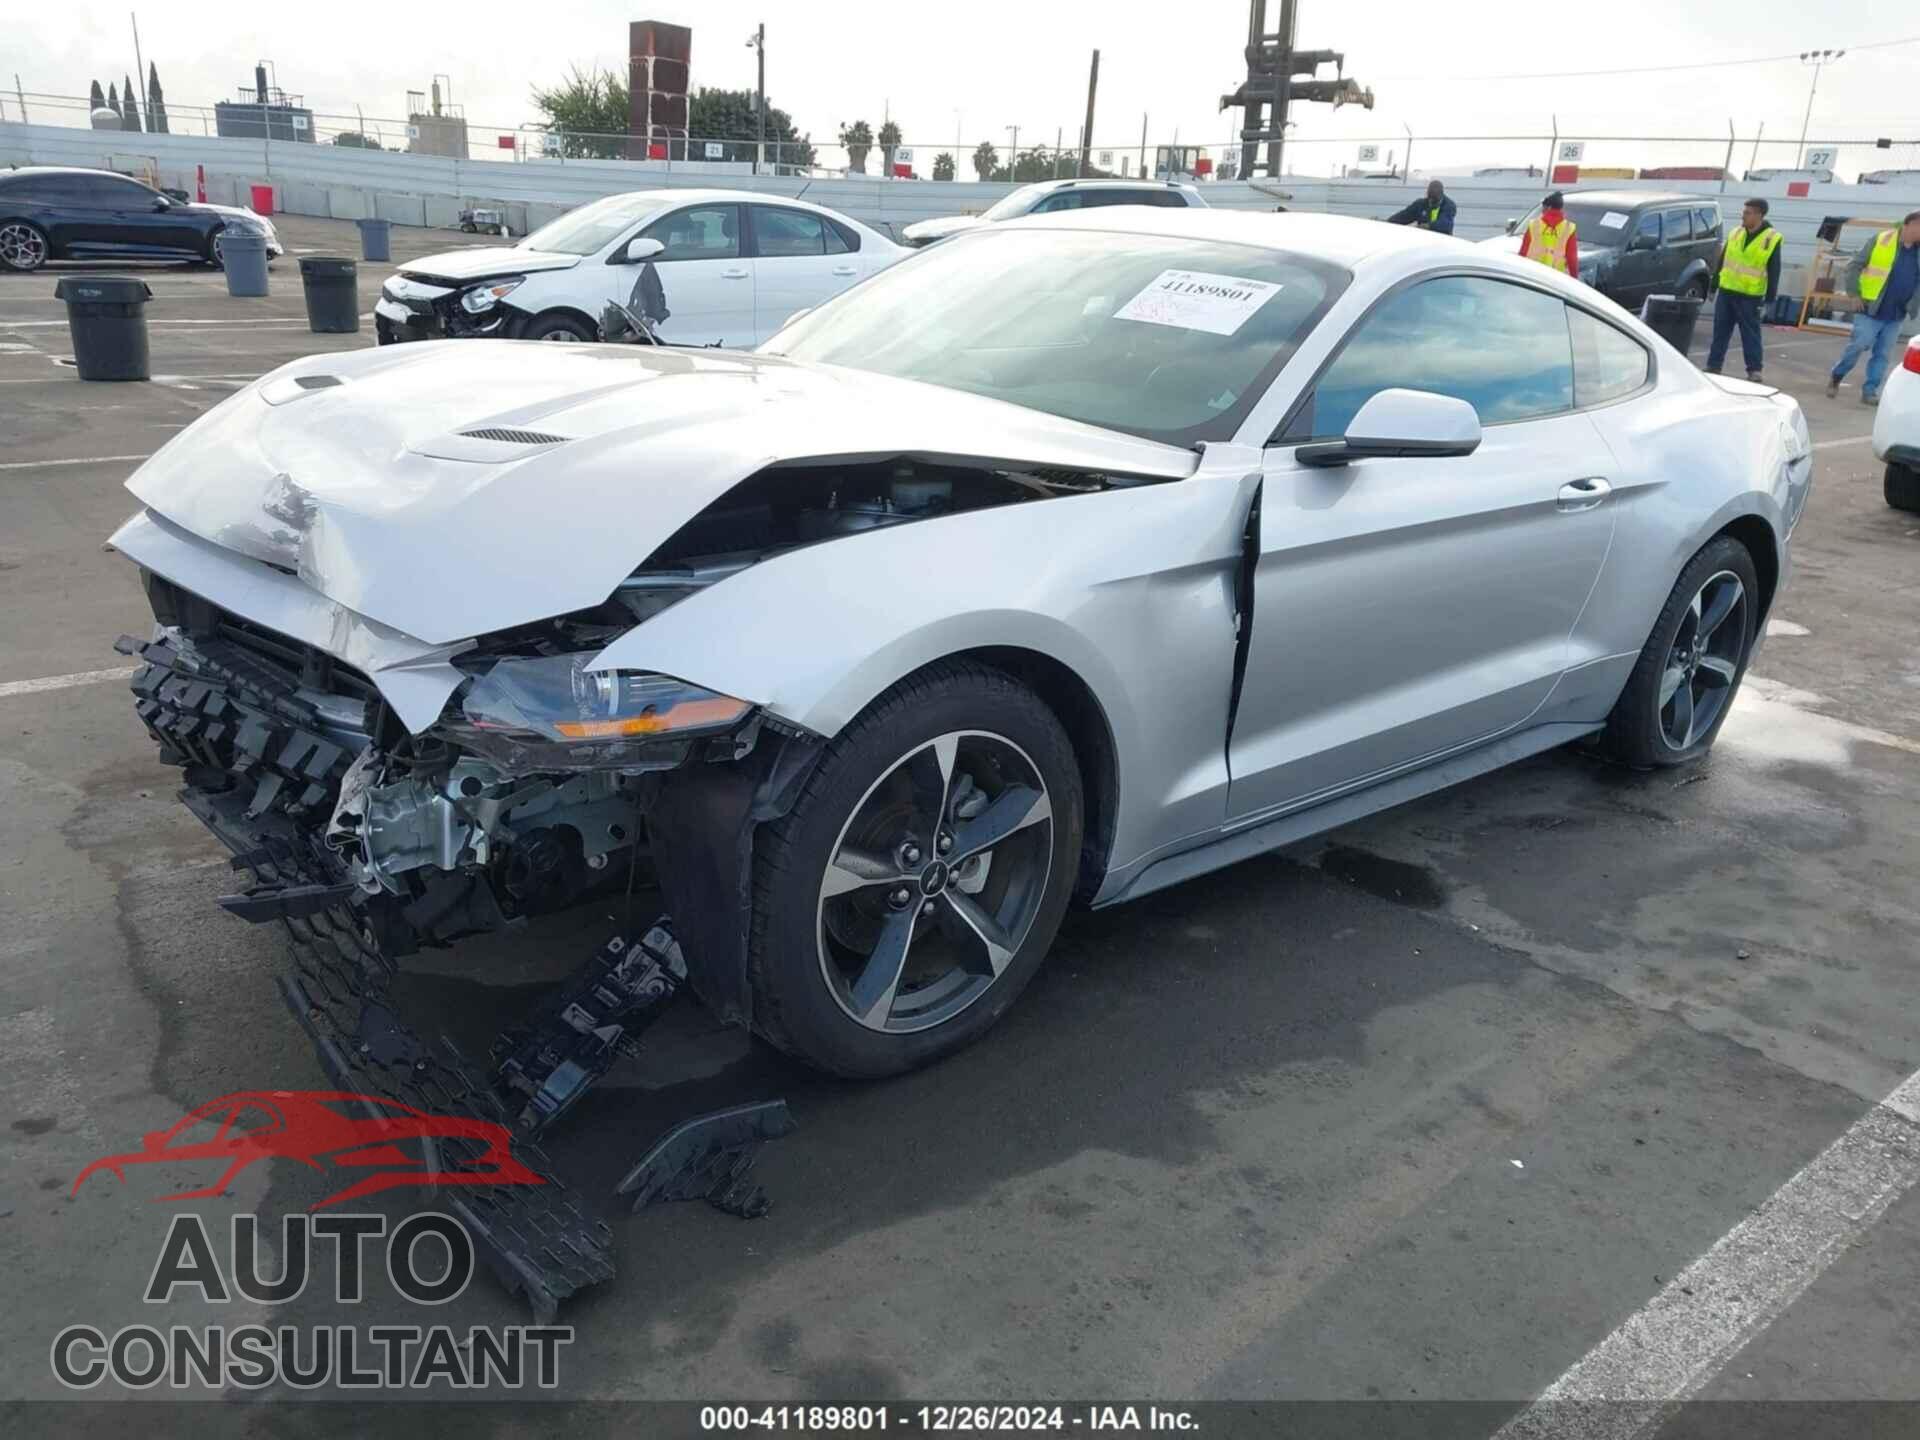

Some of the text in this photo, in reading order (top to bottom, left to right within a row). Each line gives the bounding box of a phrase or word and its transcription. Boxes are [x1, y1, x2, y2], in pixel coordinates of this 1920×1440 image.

[1564, 145, 1579, 158] 26
[1811, 152, 1831, 165] 27
[1161, 279, 1255, 302] 41189801
